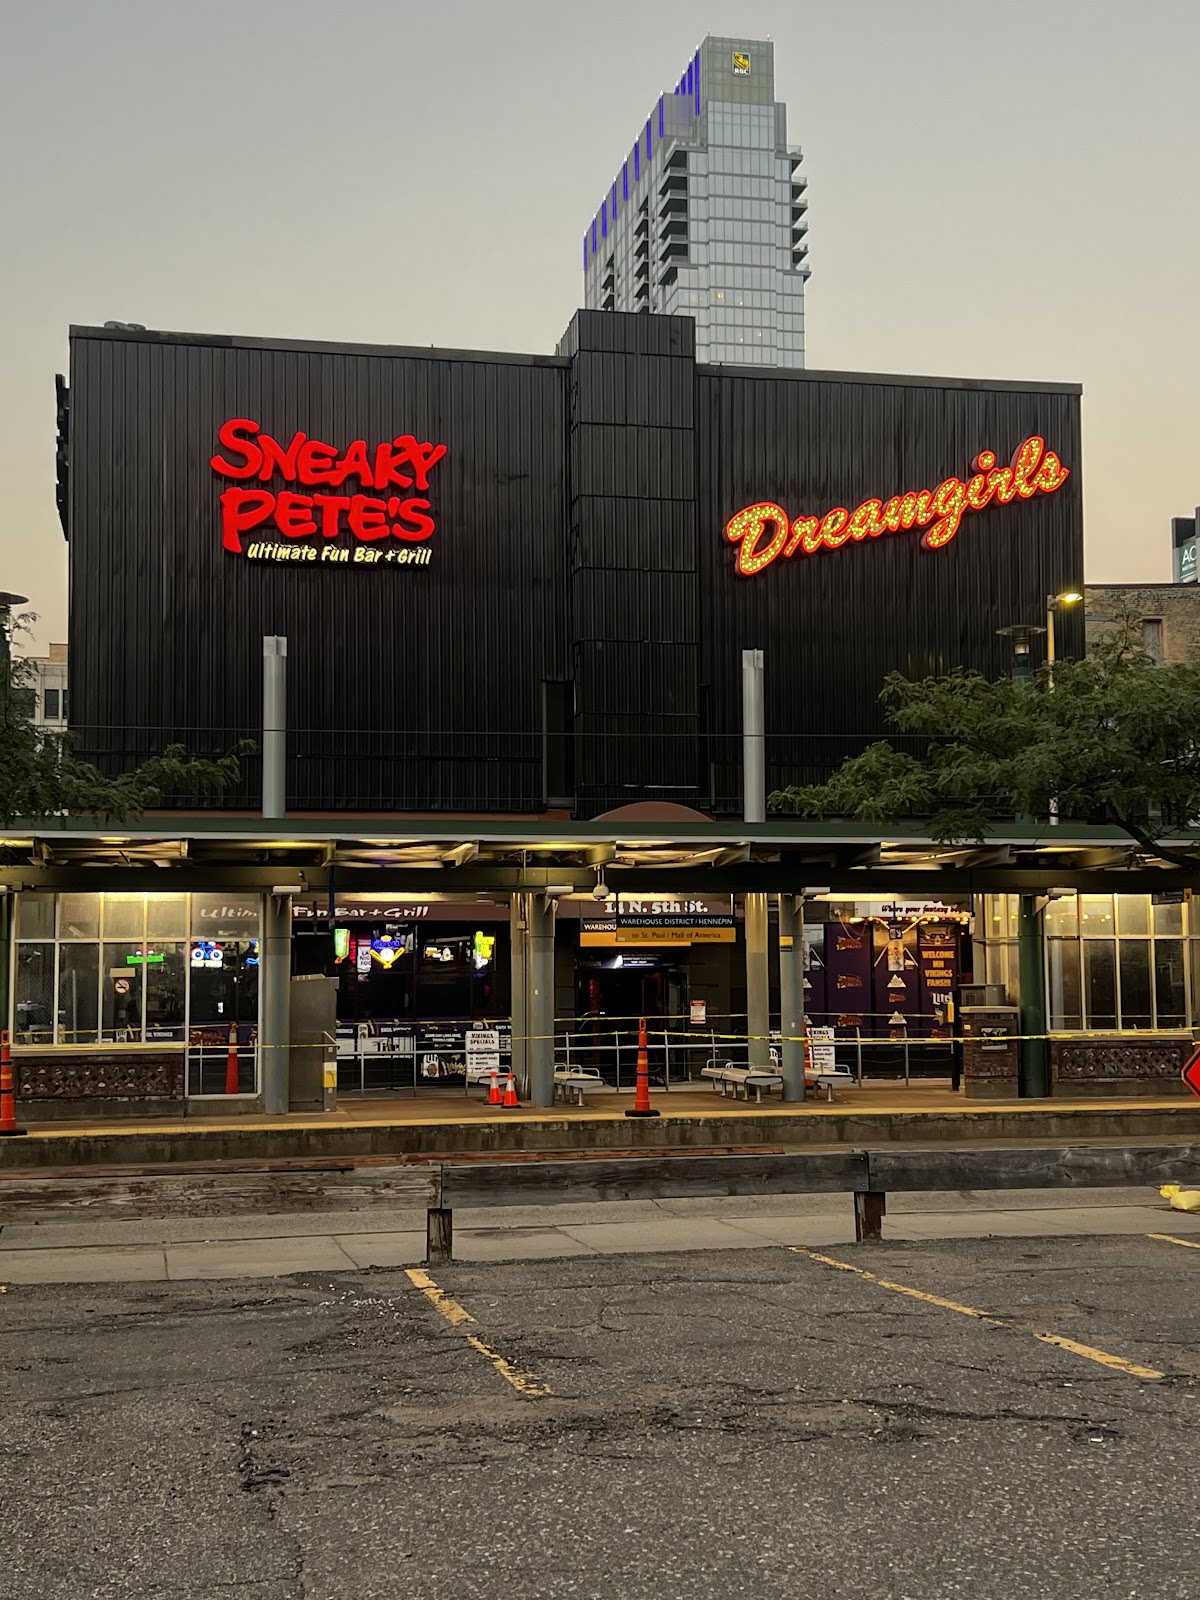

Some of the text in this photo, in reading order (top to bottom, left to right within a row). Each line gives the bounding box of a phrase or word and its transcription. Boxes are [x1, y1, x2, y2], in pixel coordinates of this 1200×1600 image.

[210, 418, 447, 490] SNEAKY
[725, 435, 1070, 575] Dreamgirls
[220, 487, 435, 553] PETE'S
[247, 542, 317, 561] Ultimate
[321, 545, 349, 562] Fun
[353, 546, 382, 563] Bar
[397, 549, 432, 565] Grill
[1182, 545, 1197, 565] AC
[628, 901, 648, 913] N.
[651, 901, 681, 914] 5th
[684, 901, 708, 913] St.
[922, 951, 955, 959] WELCOME
[924, 969, 953, 977] VIKINGS
